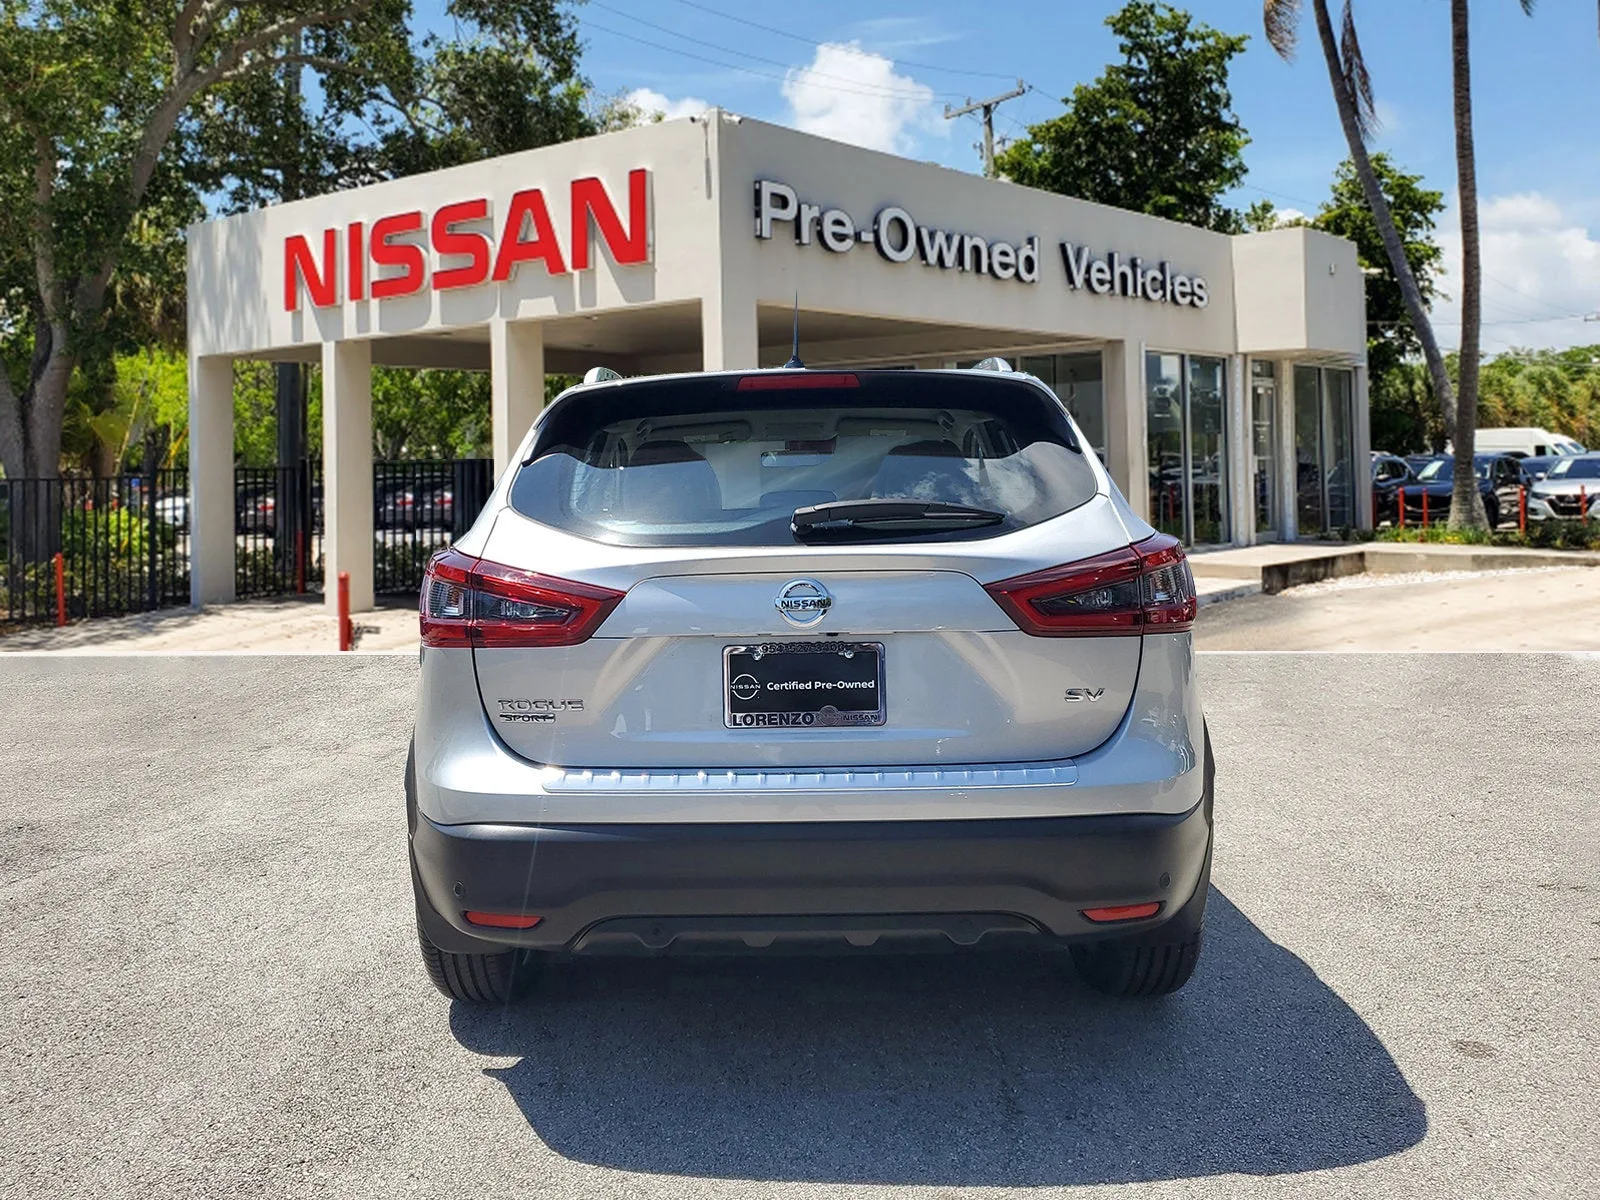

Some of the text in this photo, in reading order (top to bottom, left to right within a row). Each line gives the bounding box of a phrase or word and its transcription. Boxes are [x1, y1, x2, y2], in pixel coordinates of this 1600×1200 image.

[284, 168, 647, 312] NISSAN
[754, 179, 1209, 308] Pre-Owned Vehicles
[780, 599, 828, 610] NISSAN
[766, 680, 875, 690] Certified Pre-Owned
[1064, 688, 1105, 702] SV
[498, 699, 584, 711] ROGUE
[732, 712, 878, 726] LORENZO NISSAN
